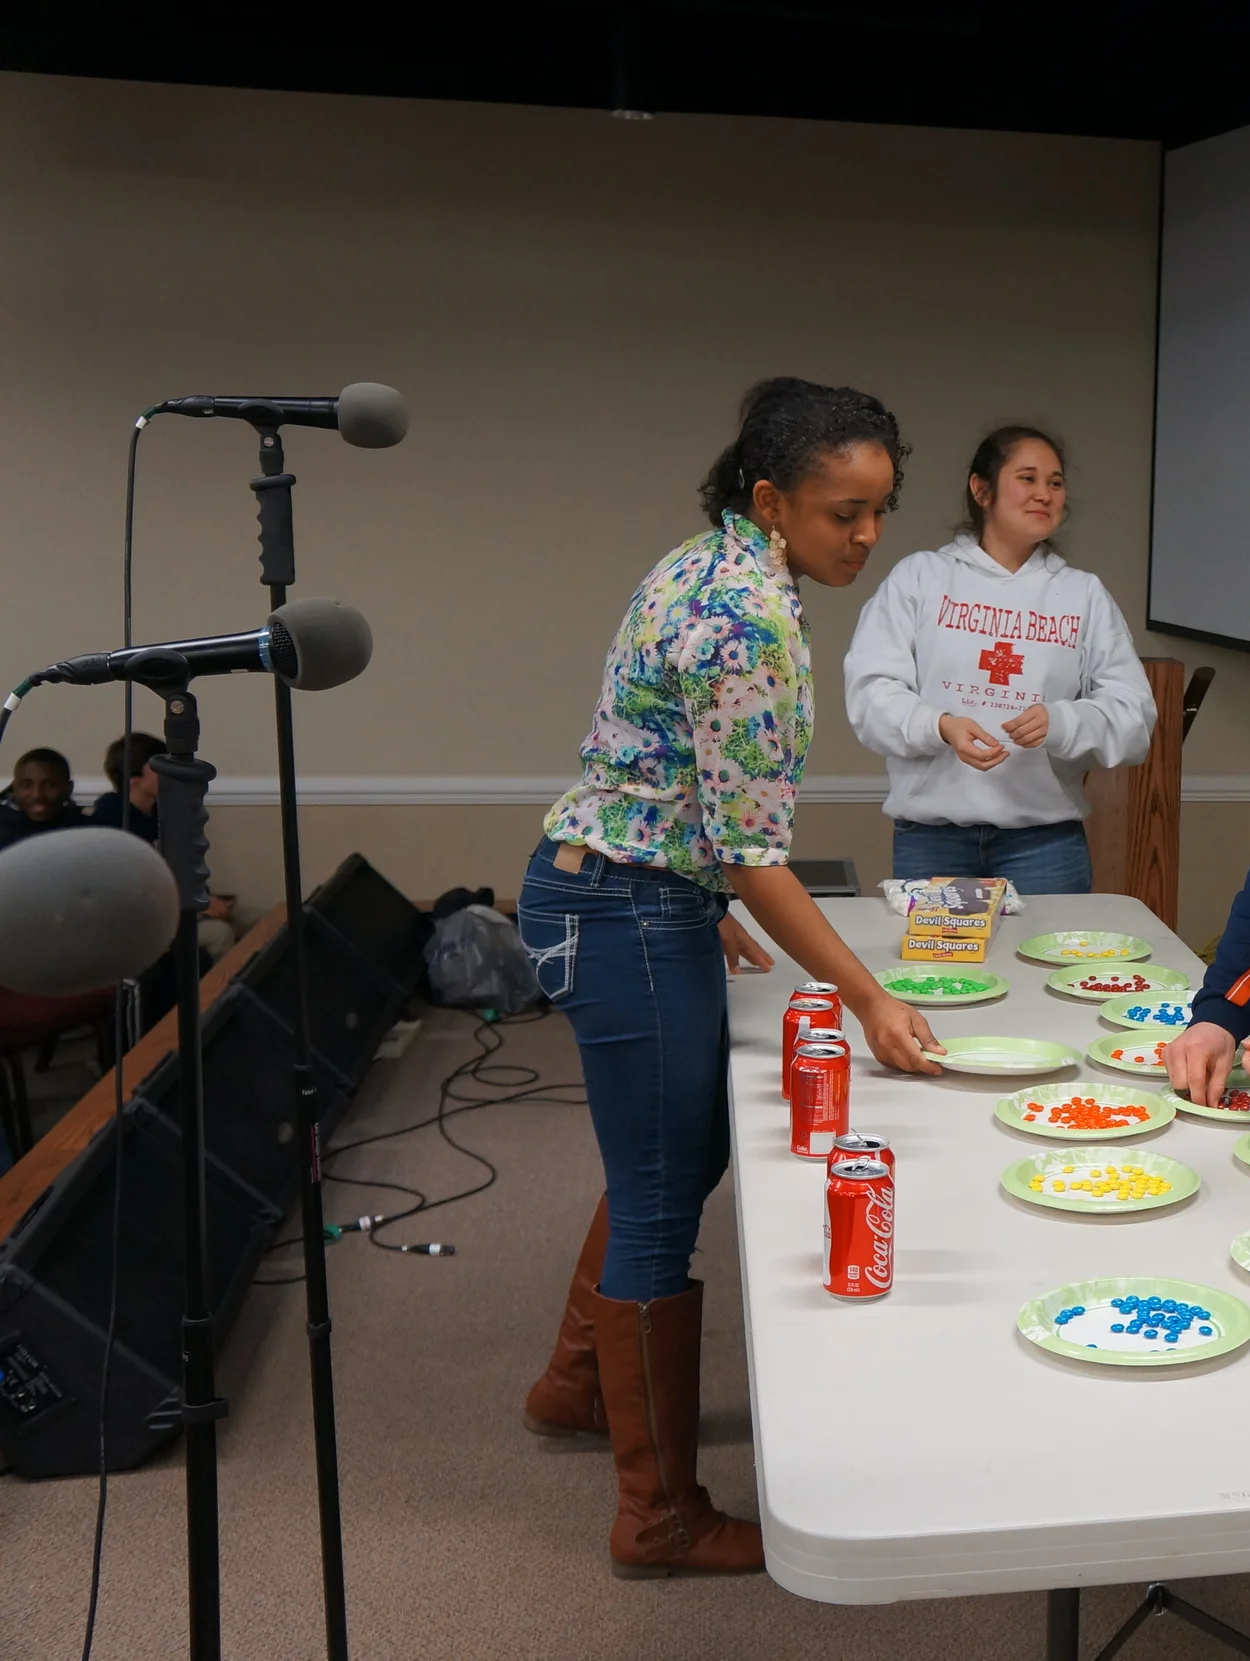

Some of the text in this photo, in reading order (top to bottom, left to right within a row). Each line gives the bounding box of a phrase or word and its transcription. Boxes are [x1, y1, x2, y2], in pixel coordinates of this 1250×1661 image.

[937, 594, 1081, 649] VIRGINIA BEACH
[942, 680, 1046, 703] VIRGINI
[915, 914, 986, 929] Devil Squares
[908, 939, 979, 953] Devil Squares
